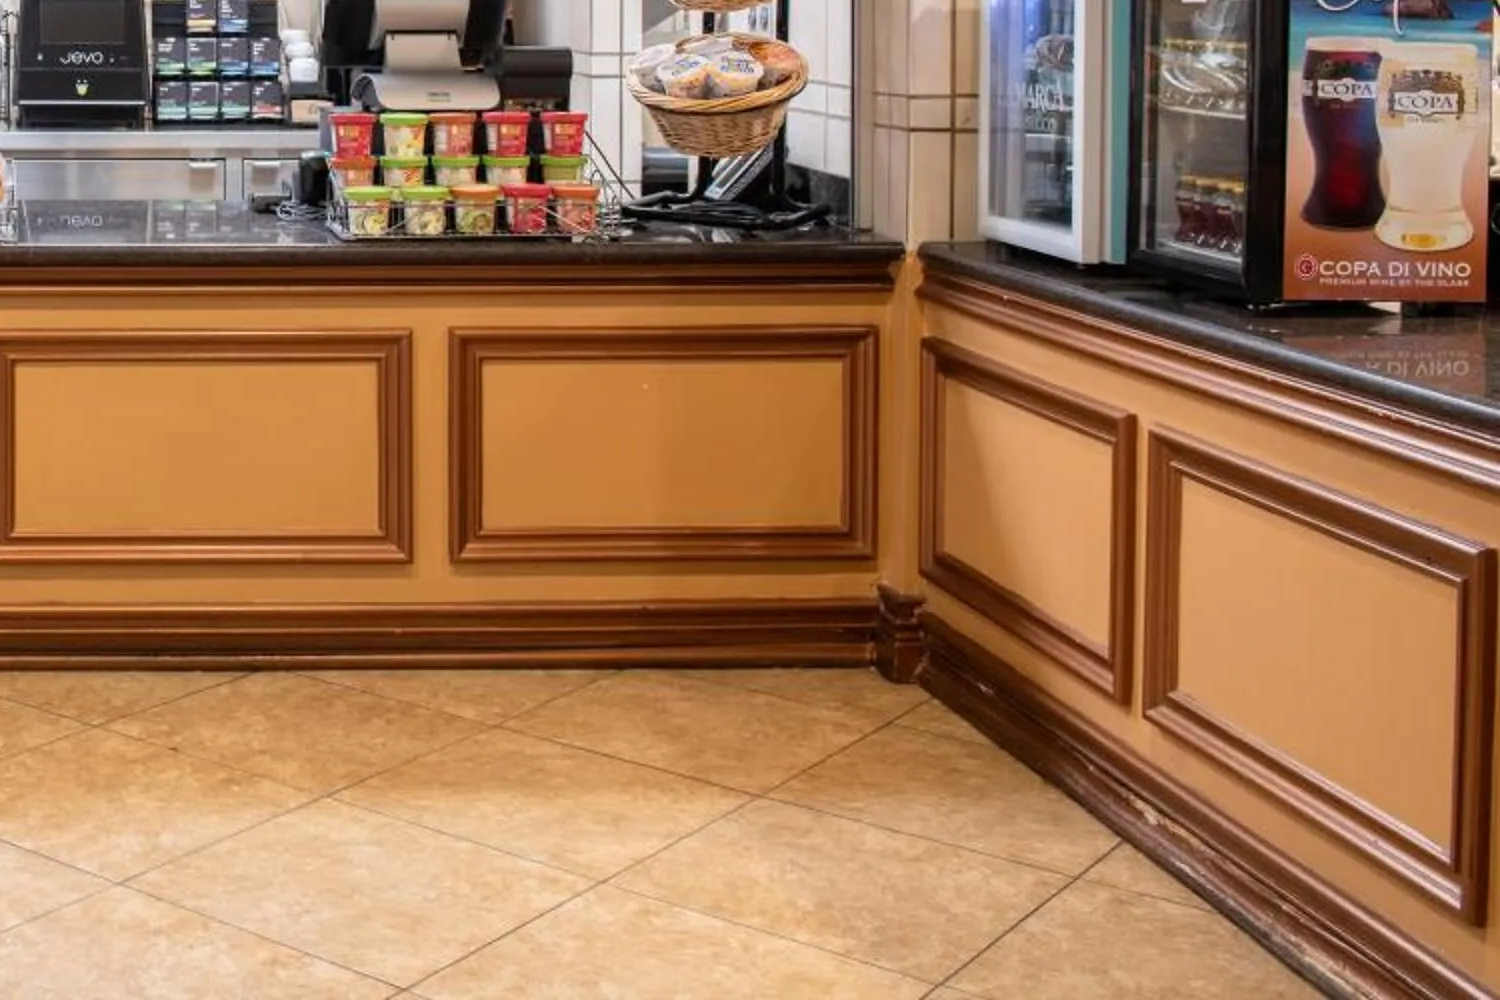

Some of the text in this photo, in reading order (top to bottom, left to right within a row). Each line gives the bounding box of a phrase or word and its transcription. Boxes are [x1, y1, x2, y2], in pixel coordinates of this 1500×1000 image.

[1321, 80, 1374, 97] COPA
[1396, 94, 1453, 110] COPA
[1320, 261, 1472, 277] COPA DI VINO
